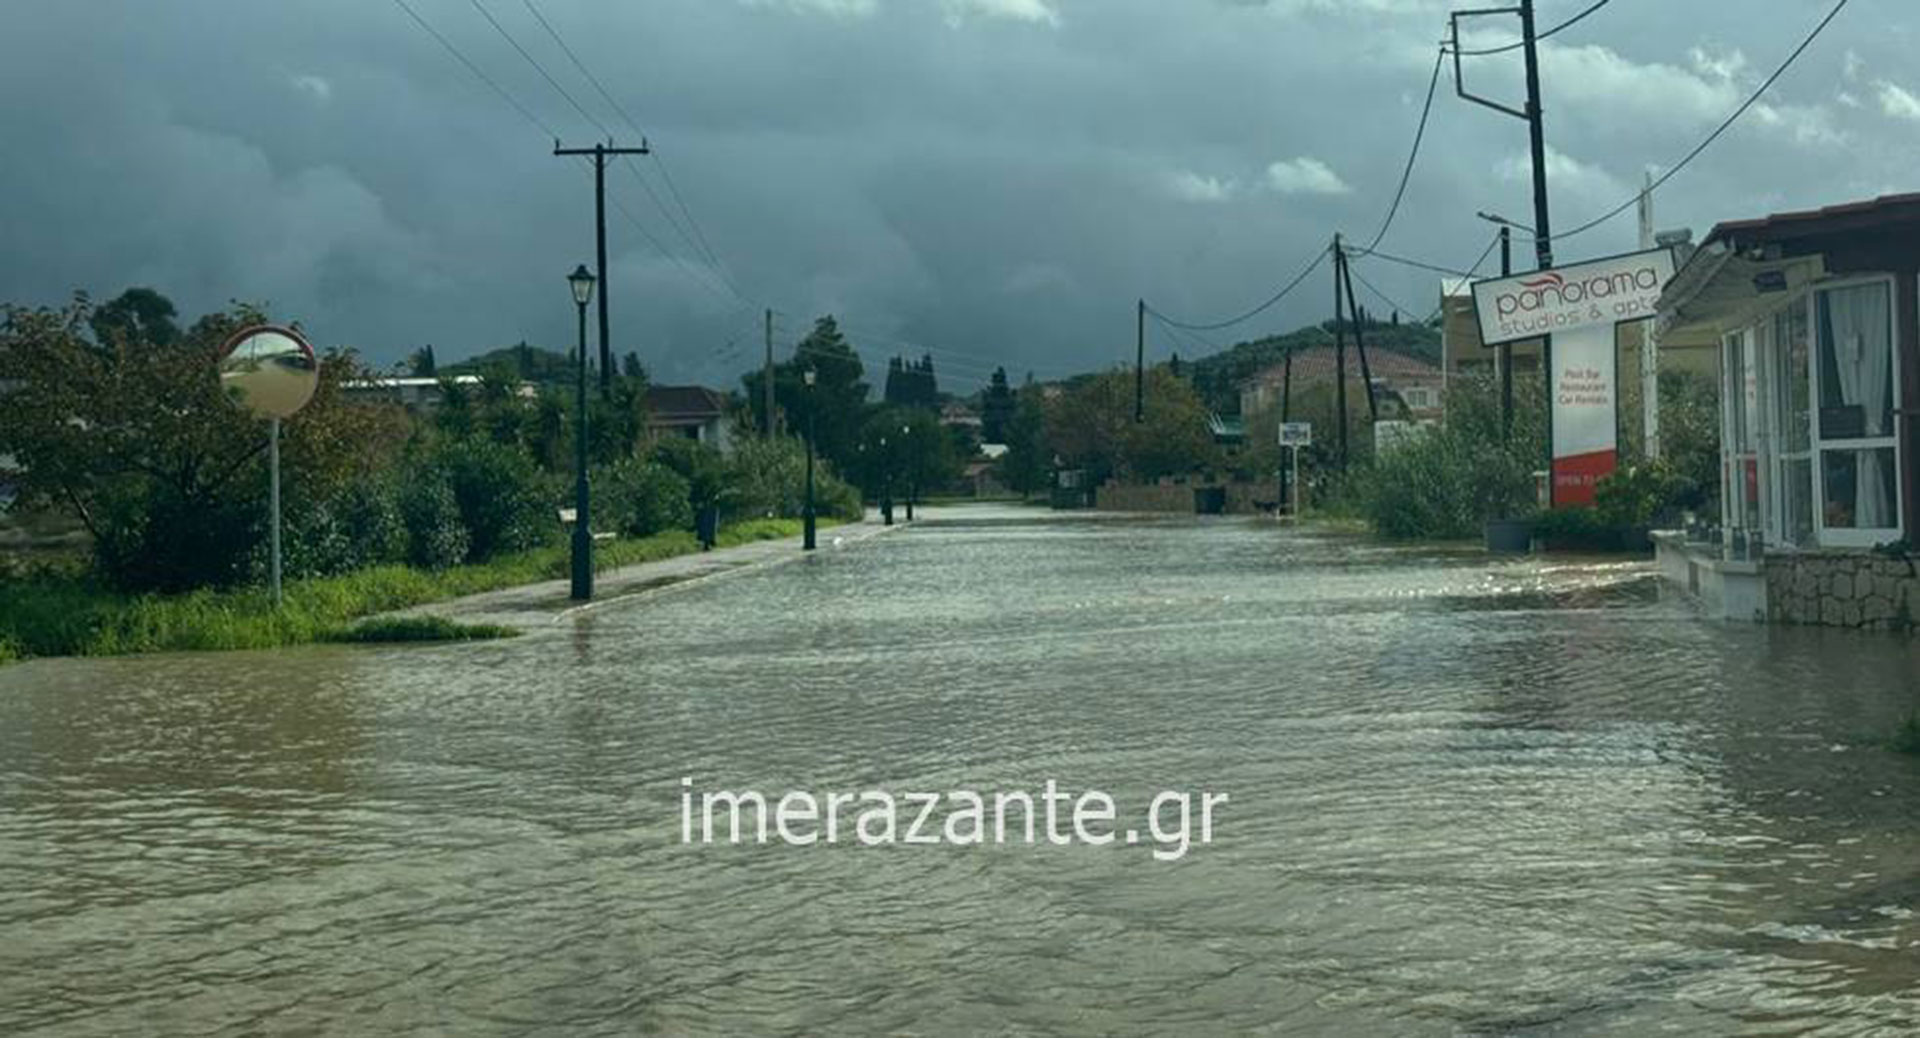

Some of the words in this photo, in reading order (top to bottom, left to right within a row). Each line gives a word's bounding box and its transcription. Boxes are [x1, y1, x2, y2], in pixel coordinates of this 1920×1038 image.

[1496, 268, 1657, 320] panorama
[1500, 310, 1579, 336] studios
[1588, 303, 1602, 320] &
